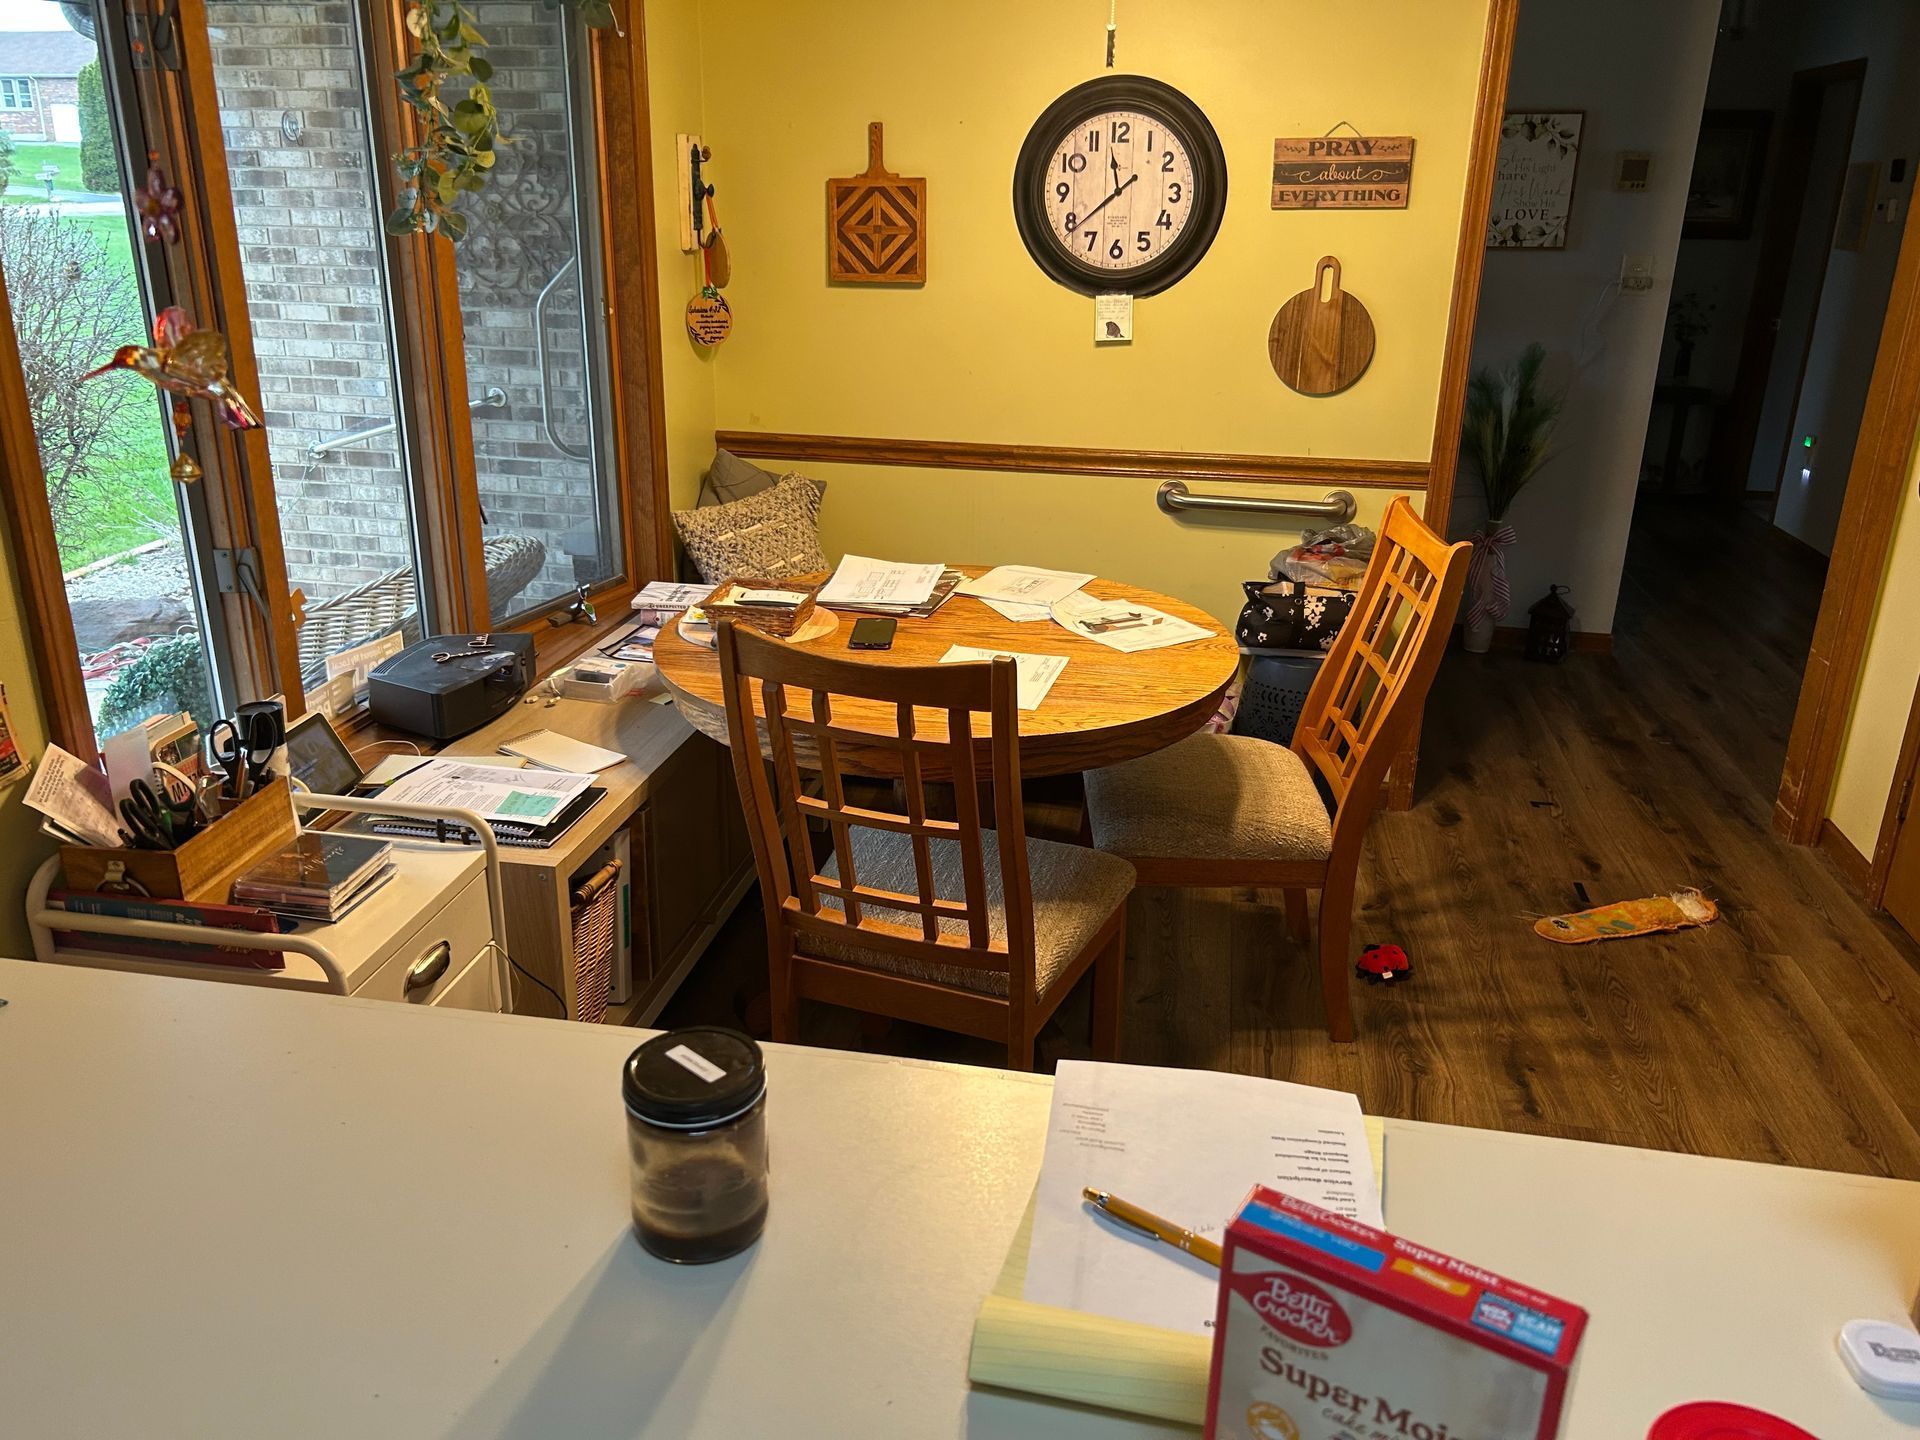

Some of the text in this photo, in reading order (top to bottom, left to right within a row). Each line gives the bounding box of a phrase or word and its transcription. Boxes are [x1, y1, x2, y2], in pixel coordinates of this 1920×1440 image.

[1089, 131, 1099, 152] 11
[1111, 122, 1130, 143] 12
[1147, 131, 1153, 152] 1
[1308, 139, 1379, 157] PRAY
[1062, 153, 1087, 173] 10
[1162, 152, 1174, 172] 2
[1318, 163, 1364, 181] about
[1497, 171, 1527, 182] hare
[1056, 182, 1070, 203] 9
[1168, 183, 1182, 203] 3
[1278, 189, 1401, 202] EVERYTHING
[1064, 212, 1077, 233] 8
[1156, 210, 1172, 230] 4
[1504, 208, 1551, 221] LOVE
[1084, 231, 1098, 252] 7
[1109, 239, 1123, 260] 6
[1137, 231, 1151, 252] 5
[1393, 1238, 1500, 1286] Super Moist
[1264, 1276, 1333, 1325] Betty
[1253, 1291, 1341, 1344] Crocker
[1259, 1346, 1369, 1414] Super
